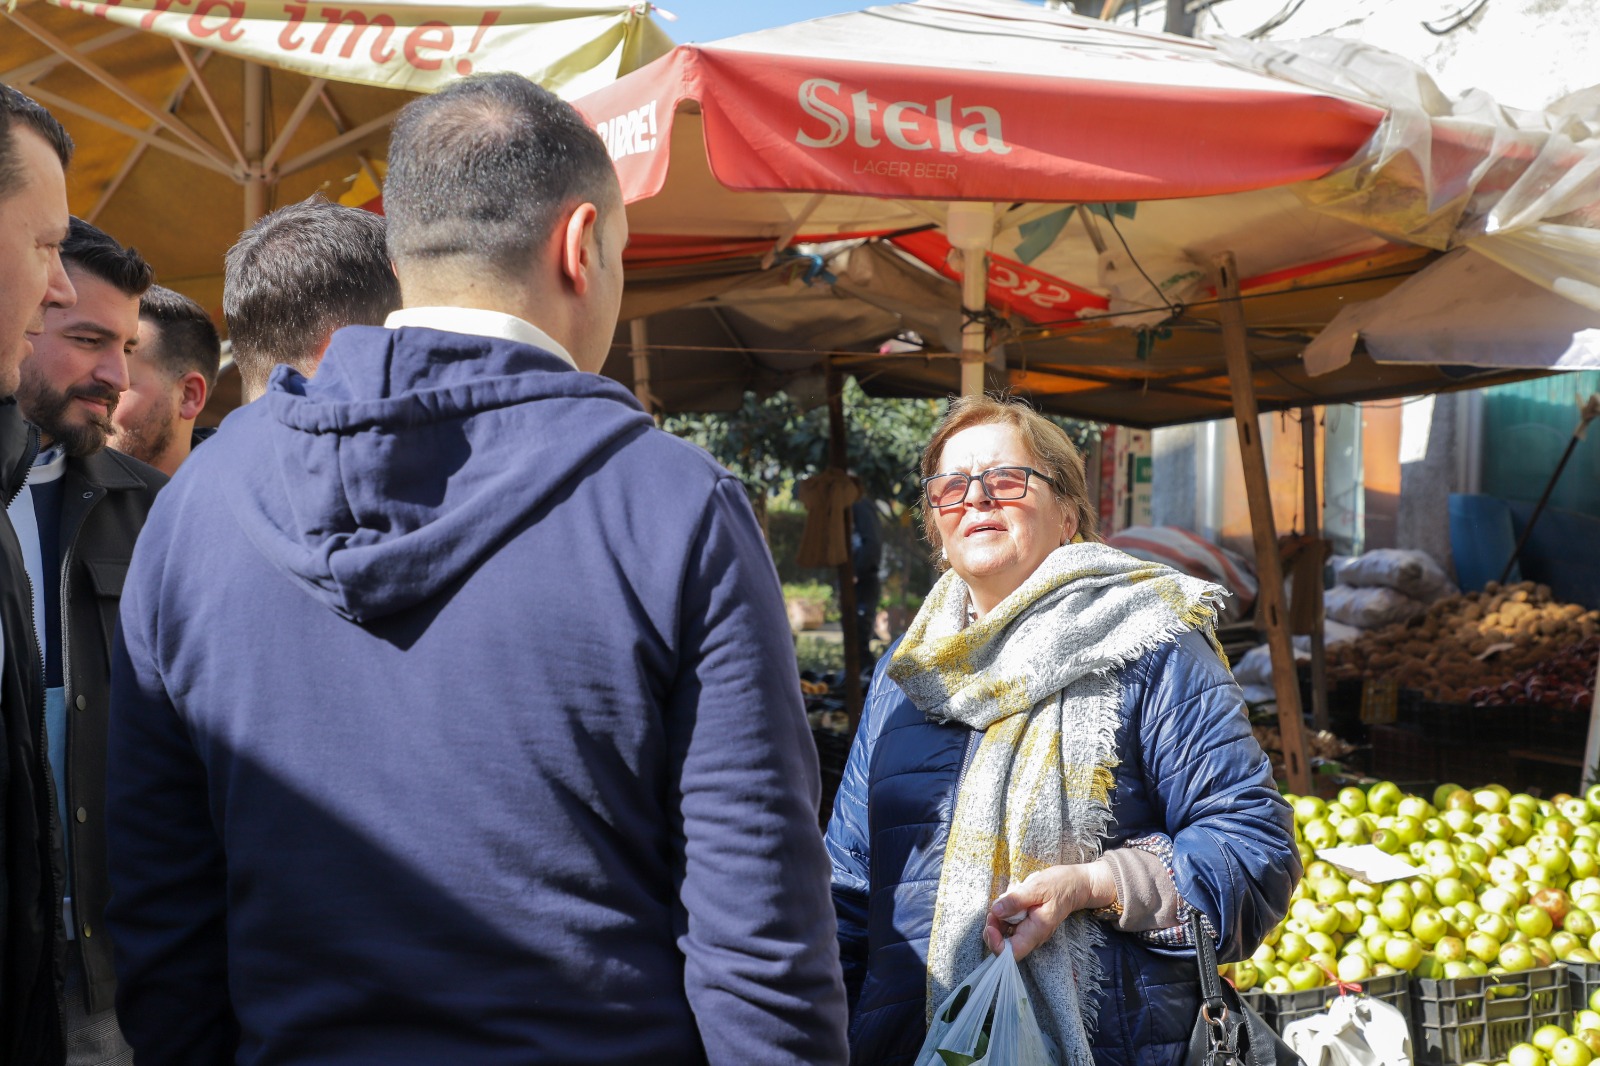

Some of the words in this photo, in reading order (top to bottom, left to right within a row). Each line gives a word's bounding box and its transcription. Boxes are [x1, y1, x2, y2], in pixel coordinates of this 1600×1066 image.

[278, 0, 501, 76] ime!
[796, 78, 1012, 155] Stela
[853, 159, 910, 177] LAGER
[914, 163, 958, 180] BEER
